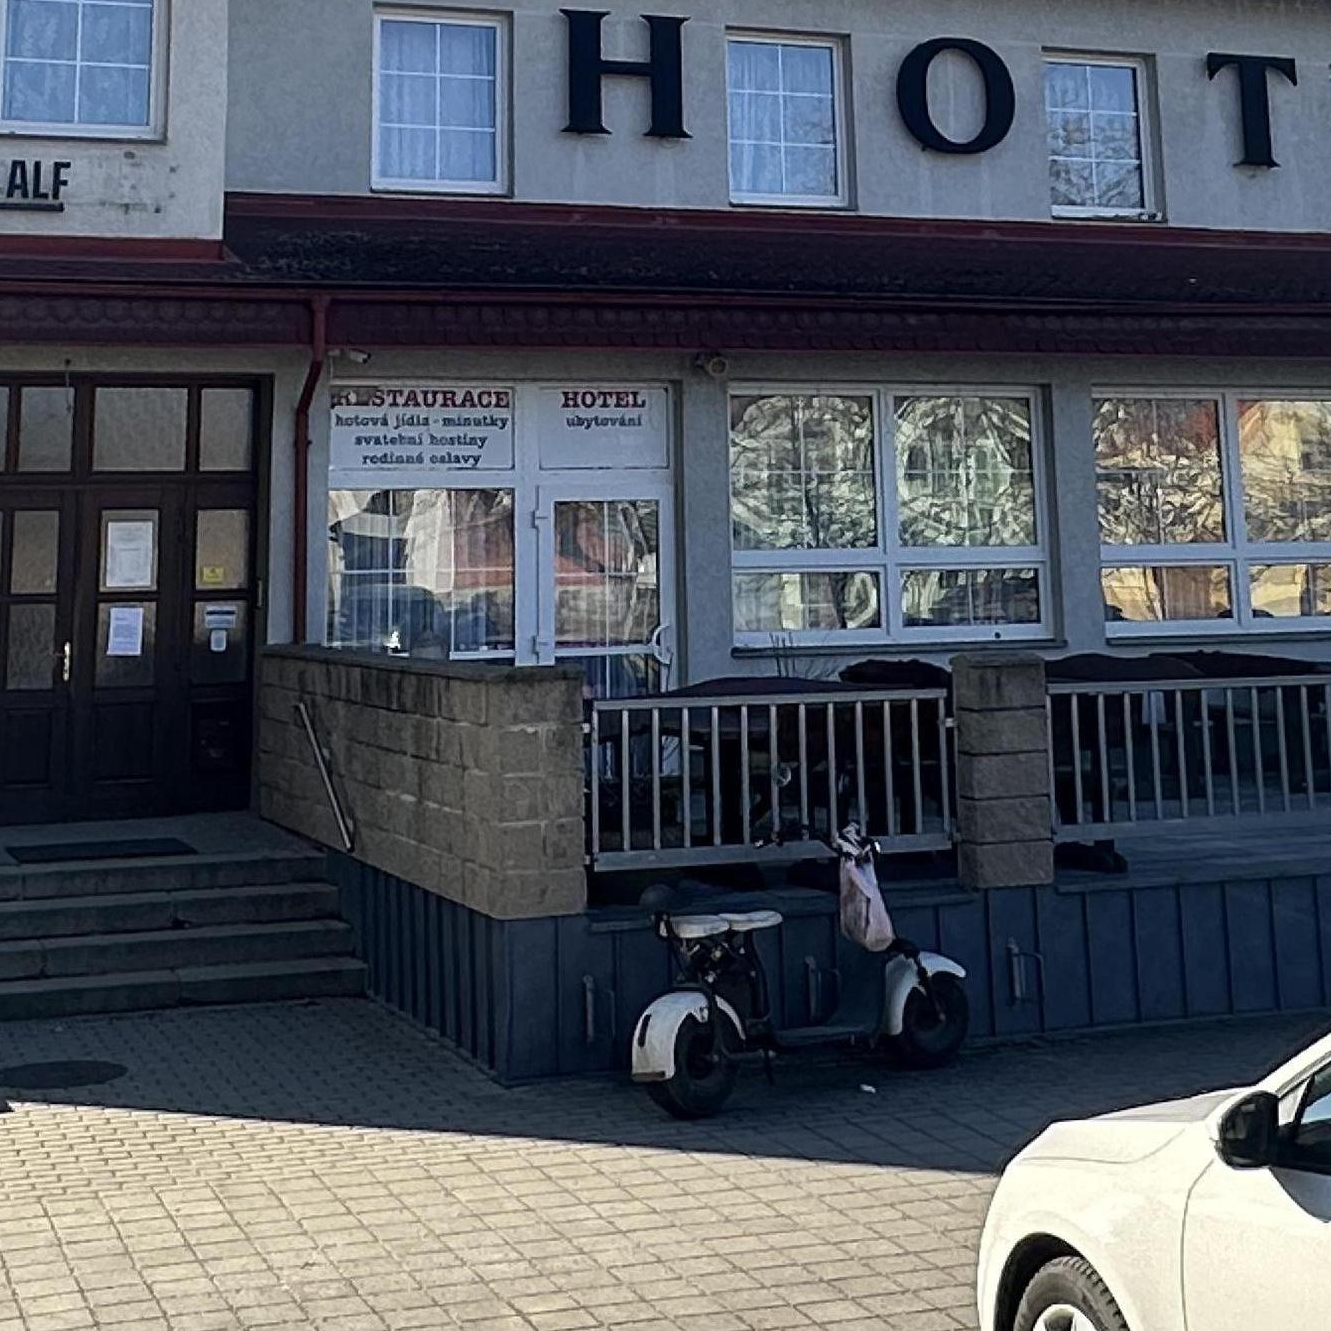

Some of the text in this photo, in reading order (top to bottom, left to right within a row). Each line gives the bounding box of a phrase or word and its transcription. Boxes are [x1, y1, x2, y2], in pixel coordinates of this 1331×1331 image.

[6, 159, 71, 200] ALF
[331, 389, 510, 408] RSTAURACE
[561, 391, 647, 408] HOTEL
[442, 414, 509, 430] minutky
[566, 414, 642, 429] ubytování
